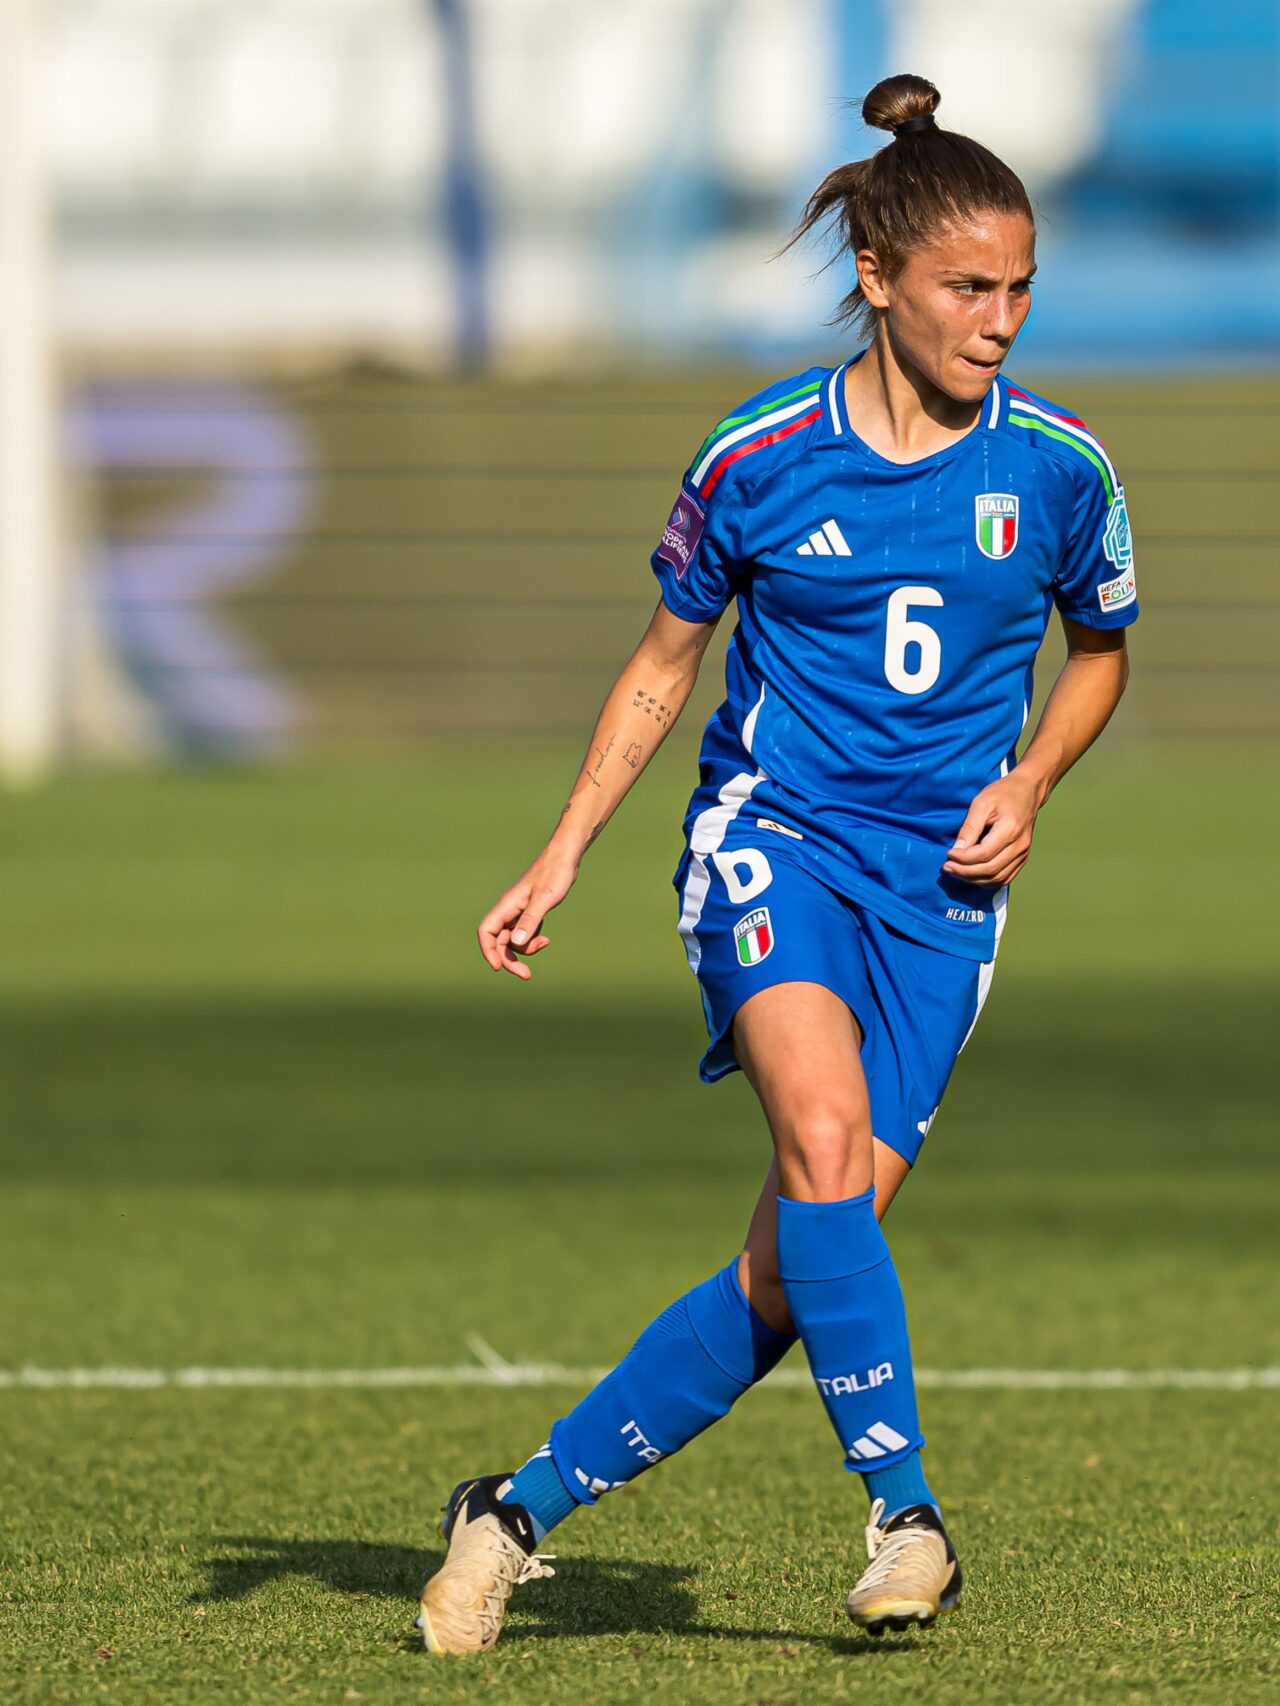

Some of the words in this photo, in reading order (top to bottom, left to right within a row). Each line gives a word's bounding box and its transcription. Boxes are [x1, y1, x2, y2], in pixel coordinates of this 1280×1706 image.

[978, 498, 1017, 513] ITALIA
[884, 585, 944, 695] 6
[735, 911, 767, 937] ITALIA
